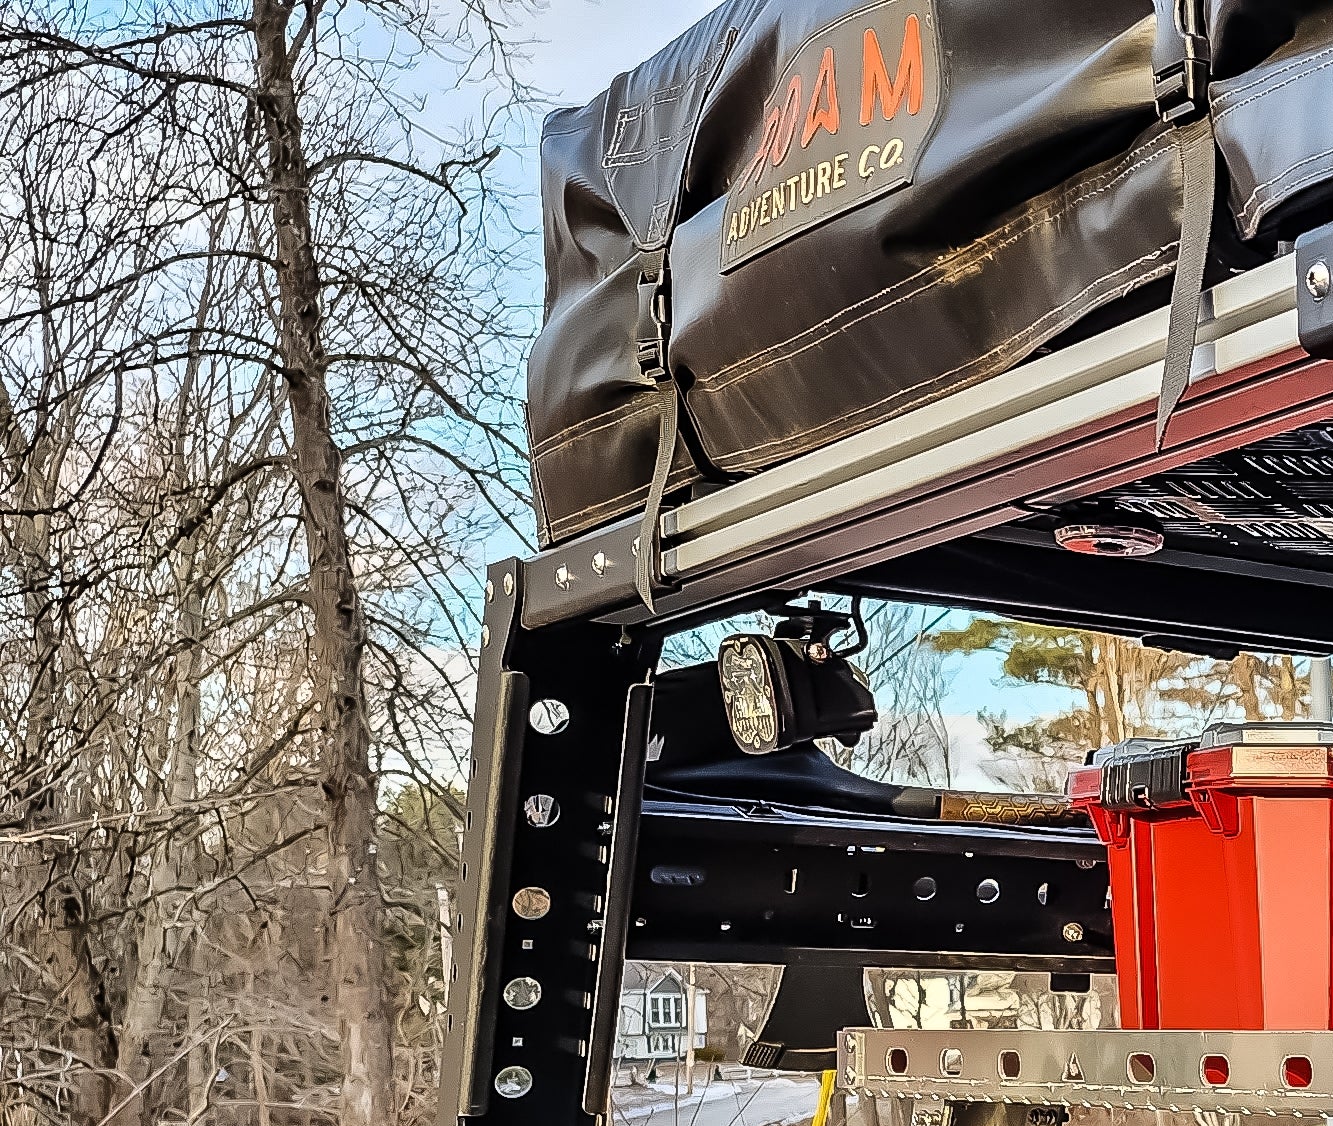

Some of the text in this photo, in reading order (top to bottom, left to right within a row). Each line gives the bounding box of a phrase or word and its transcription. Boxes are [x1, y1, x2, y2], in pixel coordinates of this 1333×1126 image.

[738, 13, 924, 196] ROAM
[727, 138, 904, 246] ADVENTURE CO.
